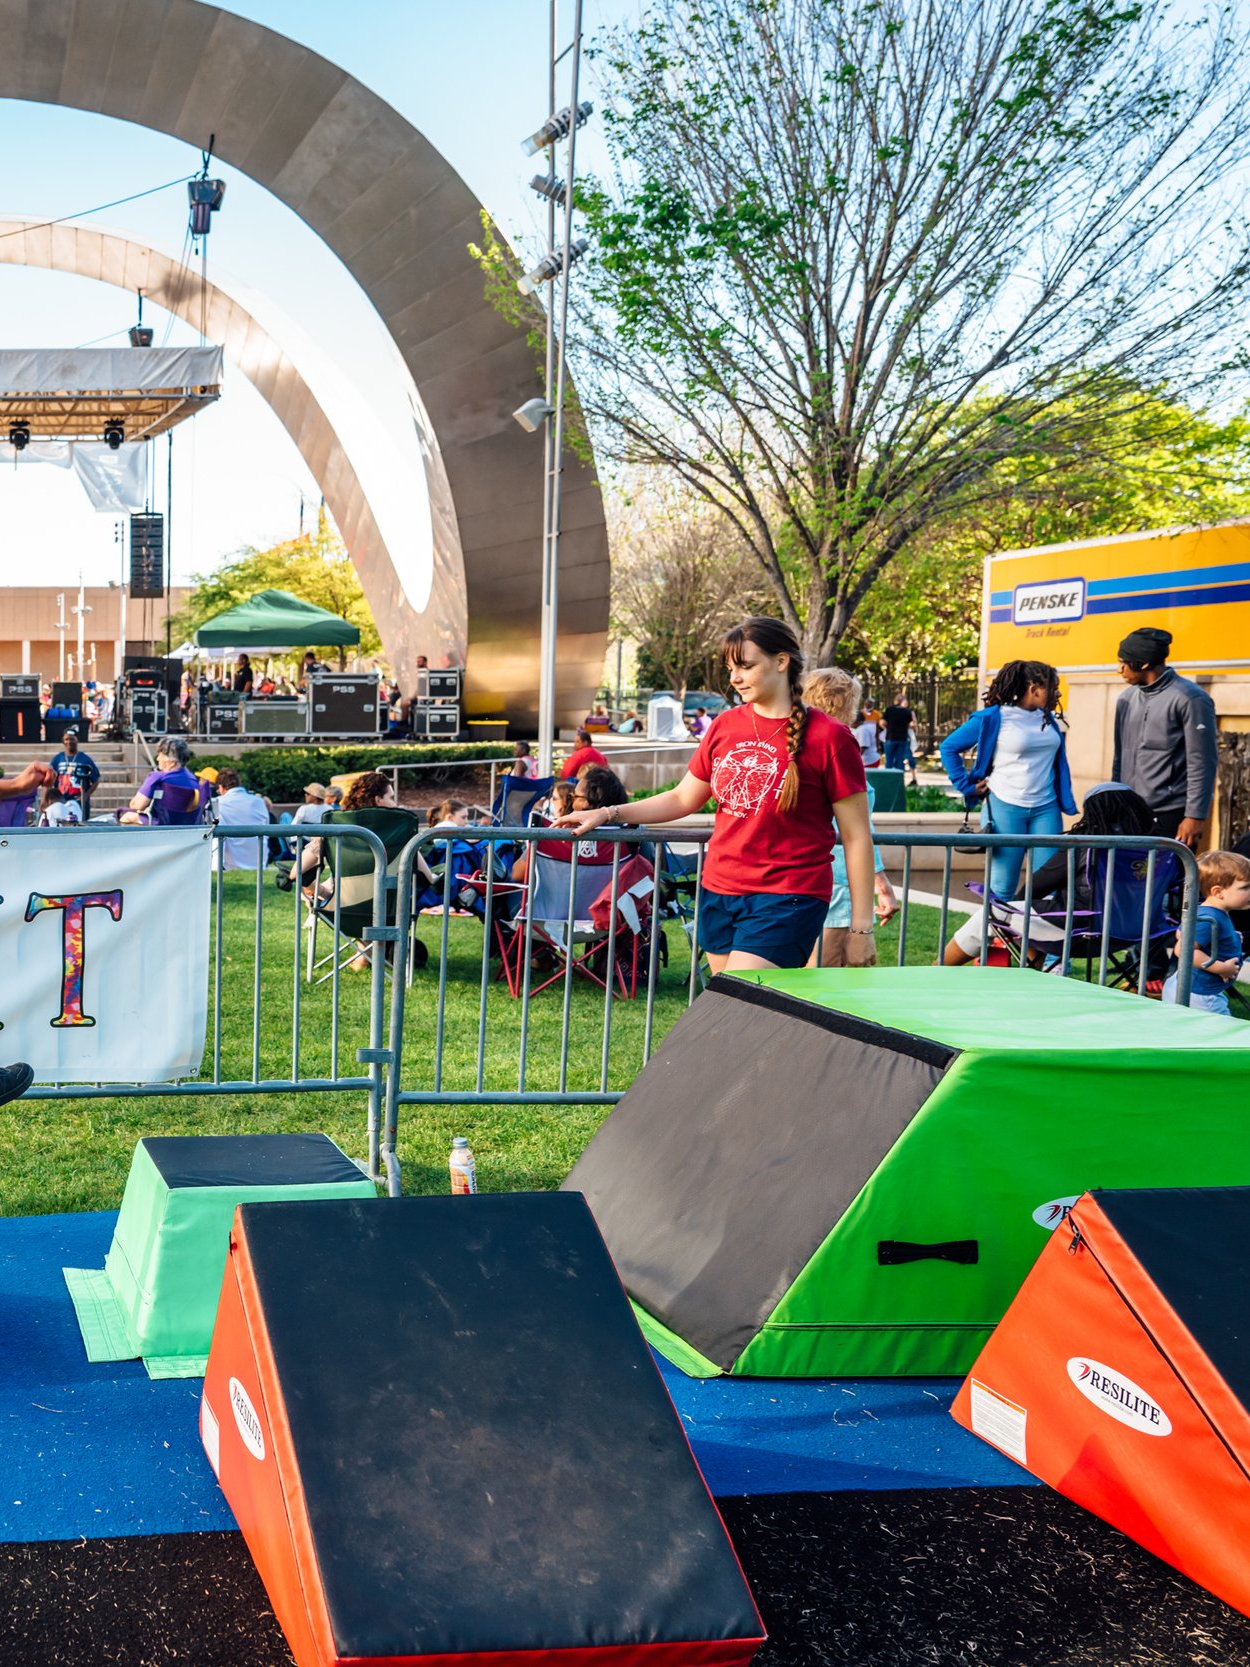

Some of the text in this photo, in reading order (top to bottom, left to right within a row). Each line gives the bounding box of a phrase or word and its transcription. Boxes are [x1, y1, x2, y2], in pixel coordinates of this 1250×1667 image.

[1019, 592, 1079, 611] PENSKE
[8, 685, 32, 694] PSS
[333, 685, 356, 693] PSS
[736, 741, 756, 749] IRON
[1090, 1369, 1161, 1426] RESILITE
[235, 1391, 262, 1449] RESILITE
